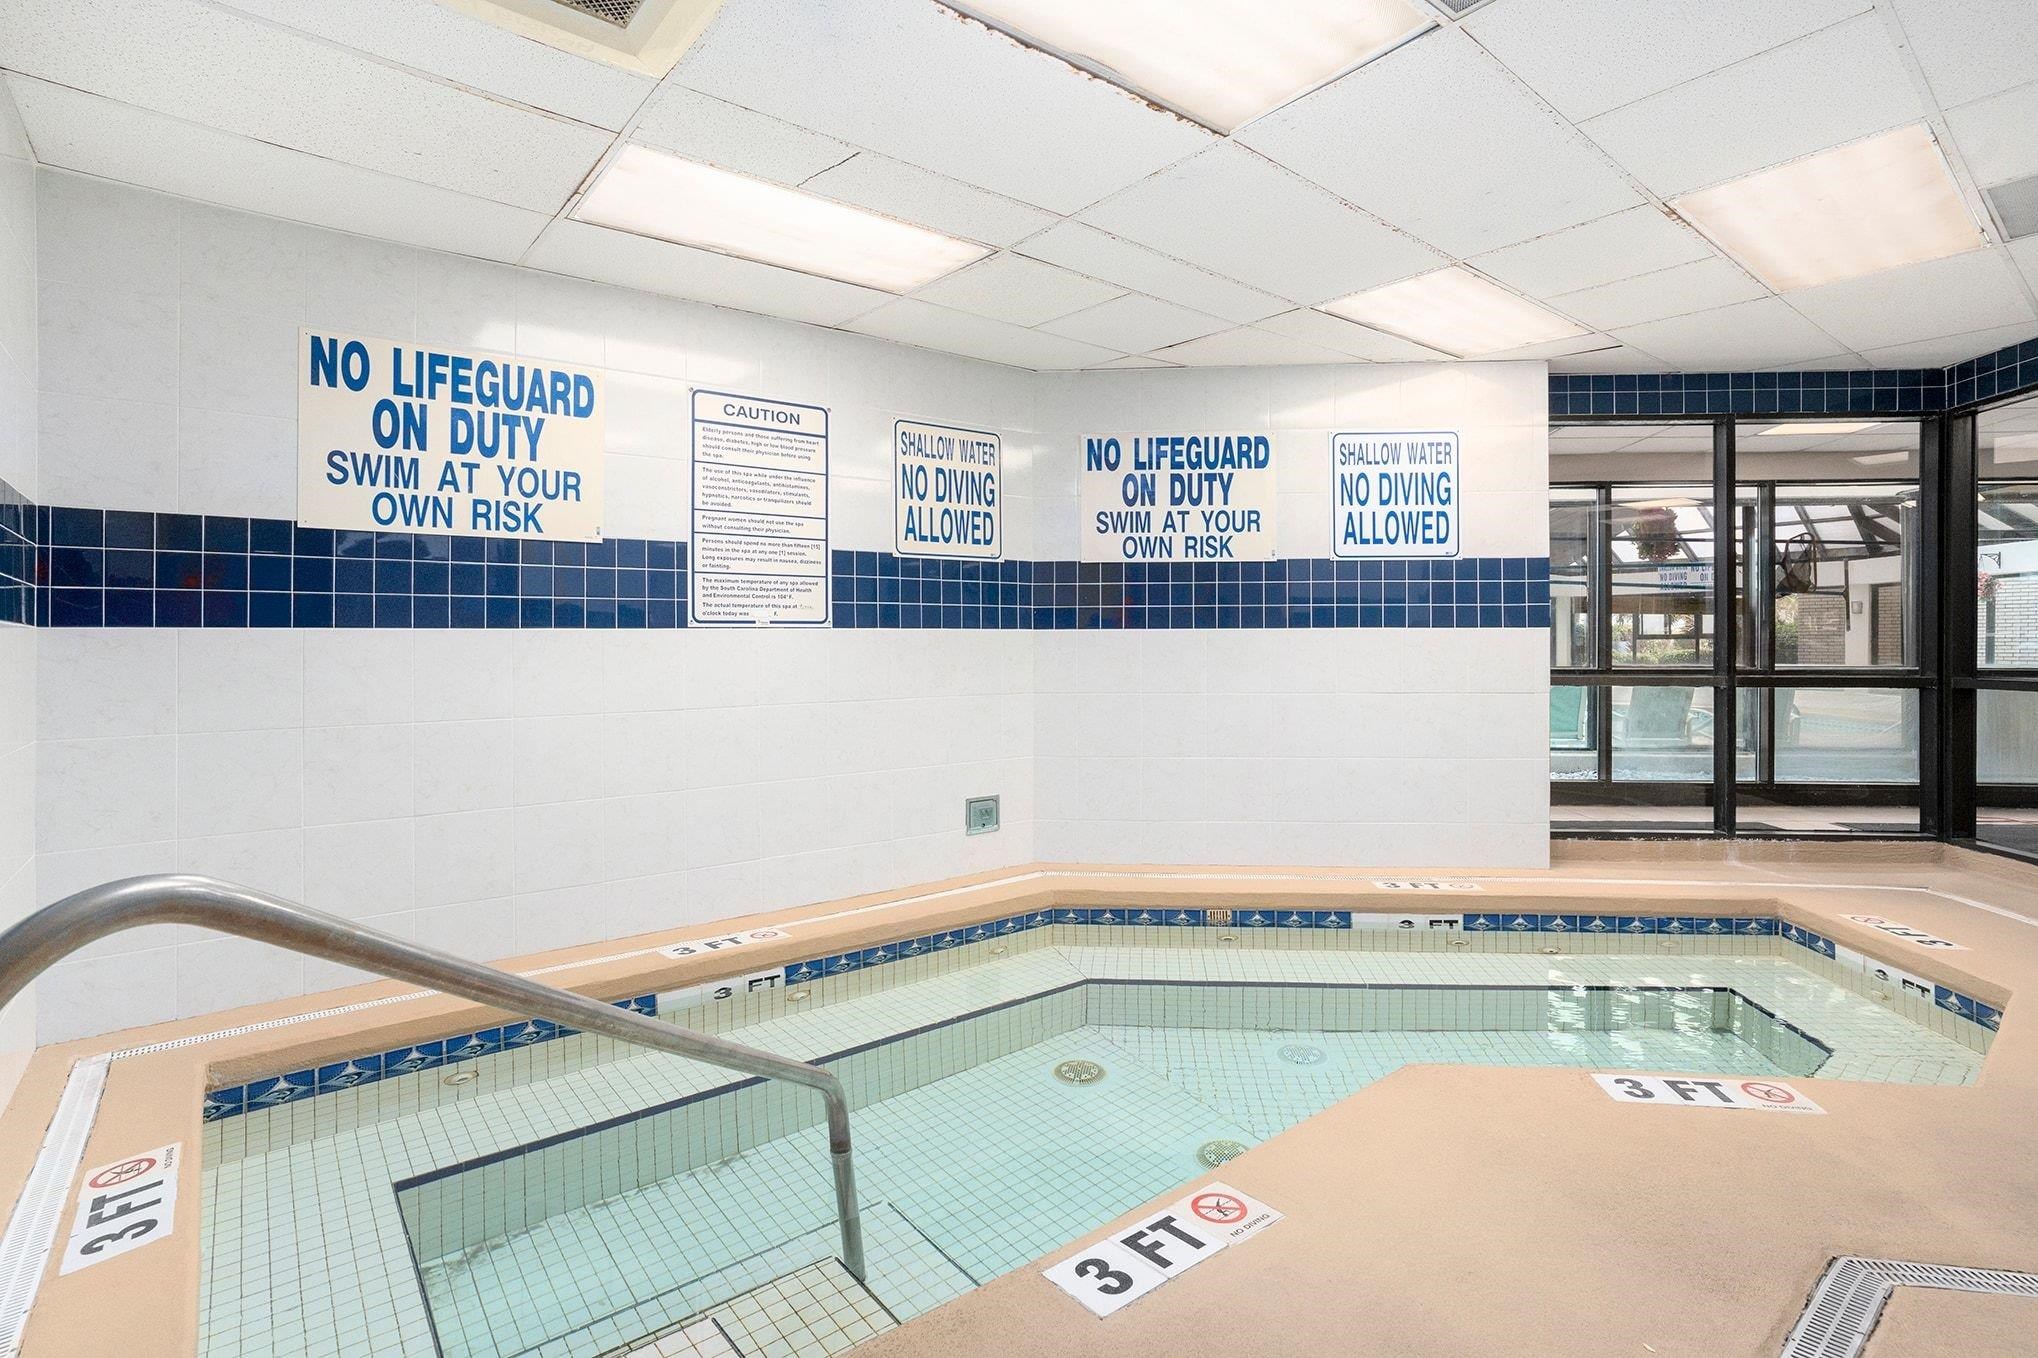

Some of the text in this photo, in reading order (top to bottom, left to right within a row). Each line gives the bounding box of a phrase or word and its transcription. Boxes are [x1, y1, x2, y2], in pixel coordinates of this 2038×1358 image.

[310, 336, 594, 418] NO LIFEGUARD
[372, 399, 545, 461] ON DUTY
[723, 404, 800, 425] CAUTION
[901, 431, 995, 466] SHALLOW WATER
[1087, 436, 1270, 471] NO LIFEGUARD
[1340, 442, 1452, 466] SHALLOW WATER
[327, 450, 581, 501] SWIM AT YOUR
[732, 479, 771, 487] anticoagulants,
[902, 464, 995, 507] NO DIVING
[1122, 473, 1233, 506] ON DUTY
[1341, 472, 1451, 506] NO DIVING
[372, 492, 543, 533] OWN RISK
[905, 506, 994, 545] ALLOWED
[1096, 510, 1260, 534] SWIM AT YOUR
[1344, 511, 1449, 545] ALLOWED
[1123, 536, 1233, 558] OWN RISK
[673, 937, 742, 955] 3 FT
[714, 974, 780, 999] 3 FT
[1614, 1078, 1735, 1103] 3 FT
[80, 1180, 163, 1255] 3 FT
[1230, 1214, 1270, 1237] NO DIVING
[1075, 1215, 1206, 1295] 3 FT
